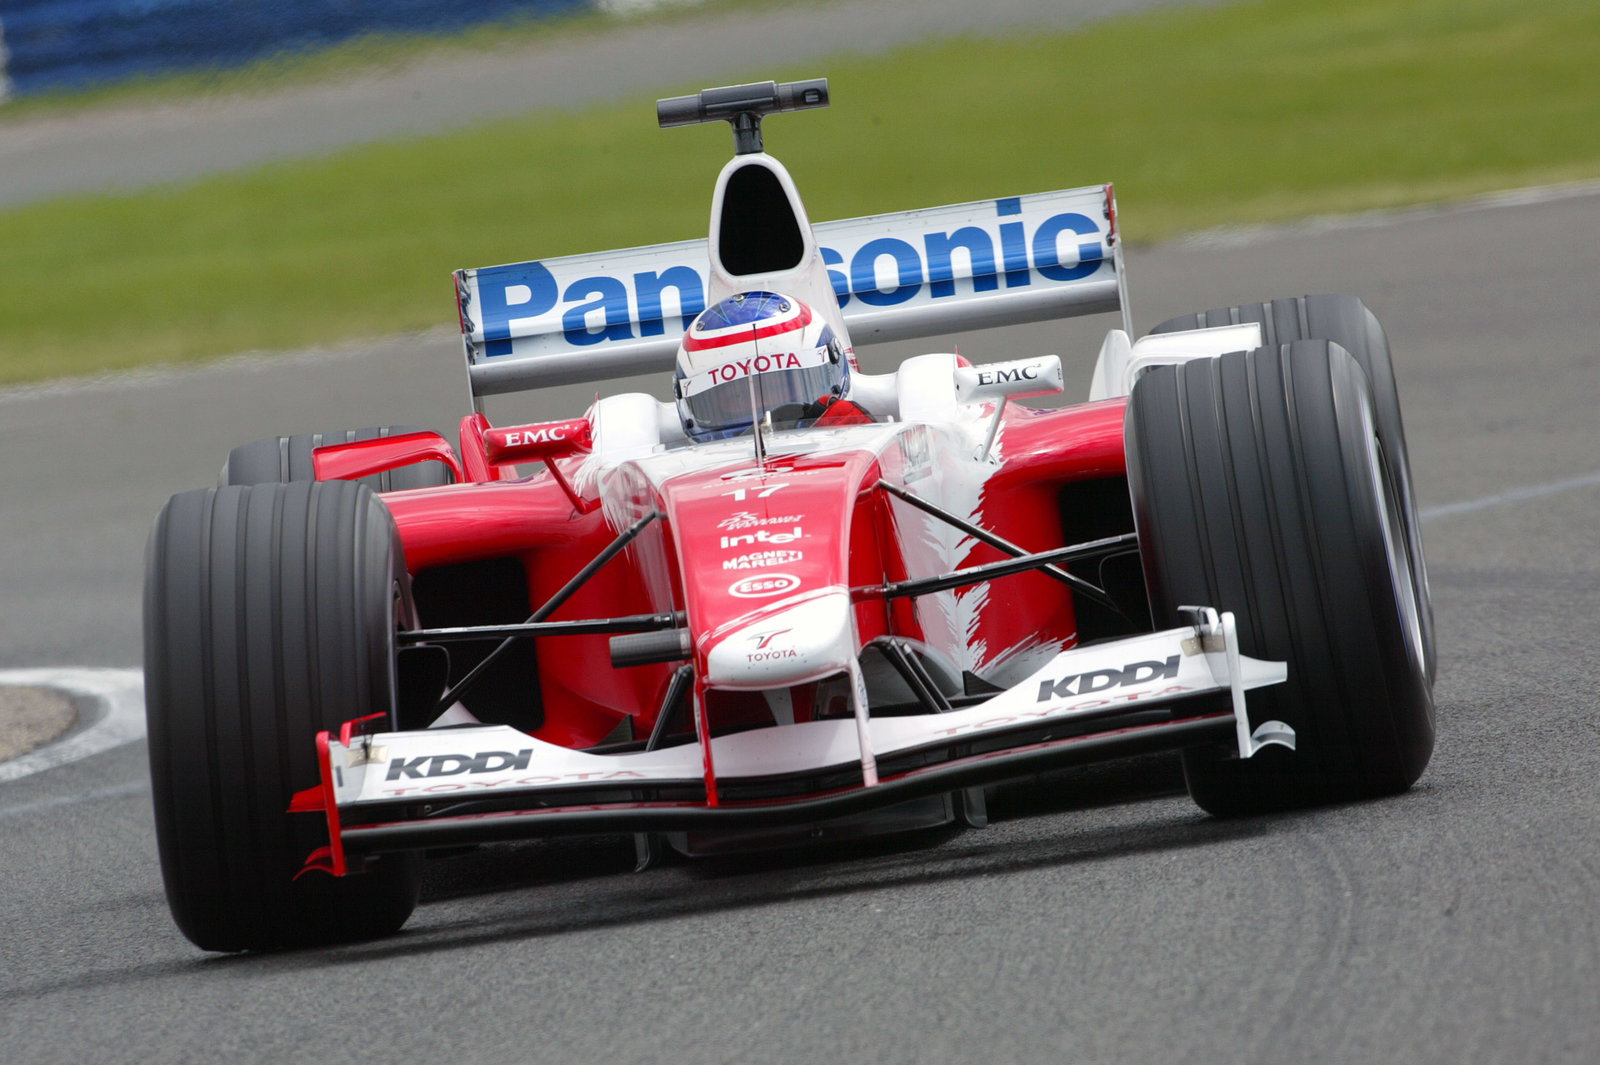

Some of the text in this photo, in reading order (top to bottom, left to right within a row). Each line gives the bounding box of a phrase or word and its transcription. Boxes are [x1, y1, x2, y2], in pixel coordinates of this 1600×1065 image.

[708, 353, 801, 385] TOYOTA
[721, 483, 790, 501] 17
[747, 649, 797, 663] TOYOTA
[1037, 654, 1180, 702] KDDI
[385, 748, 534, 781] KDDI
